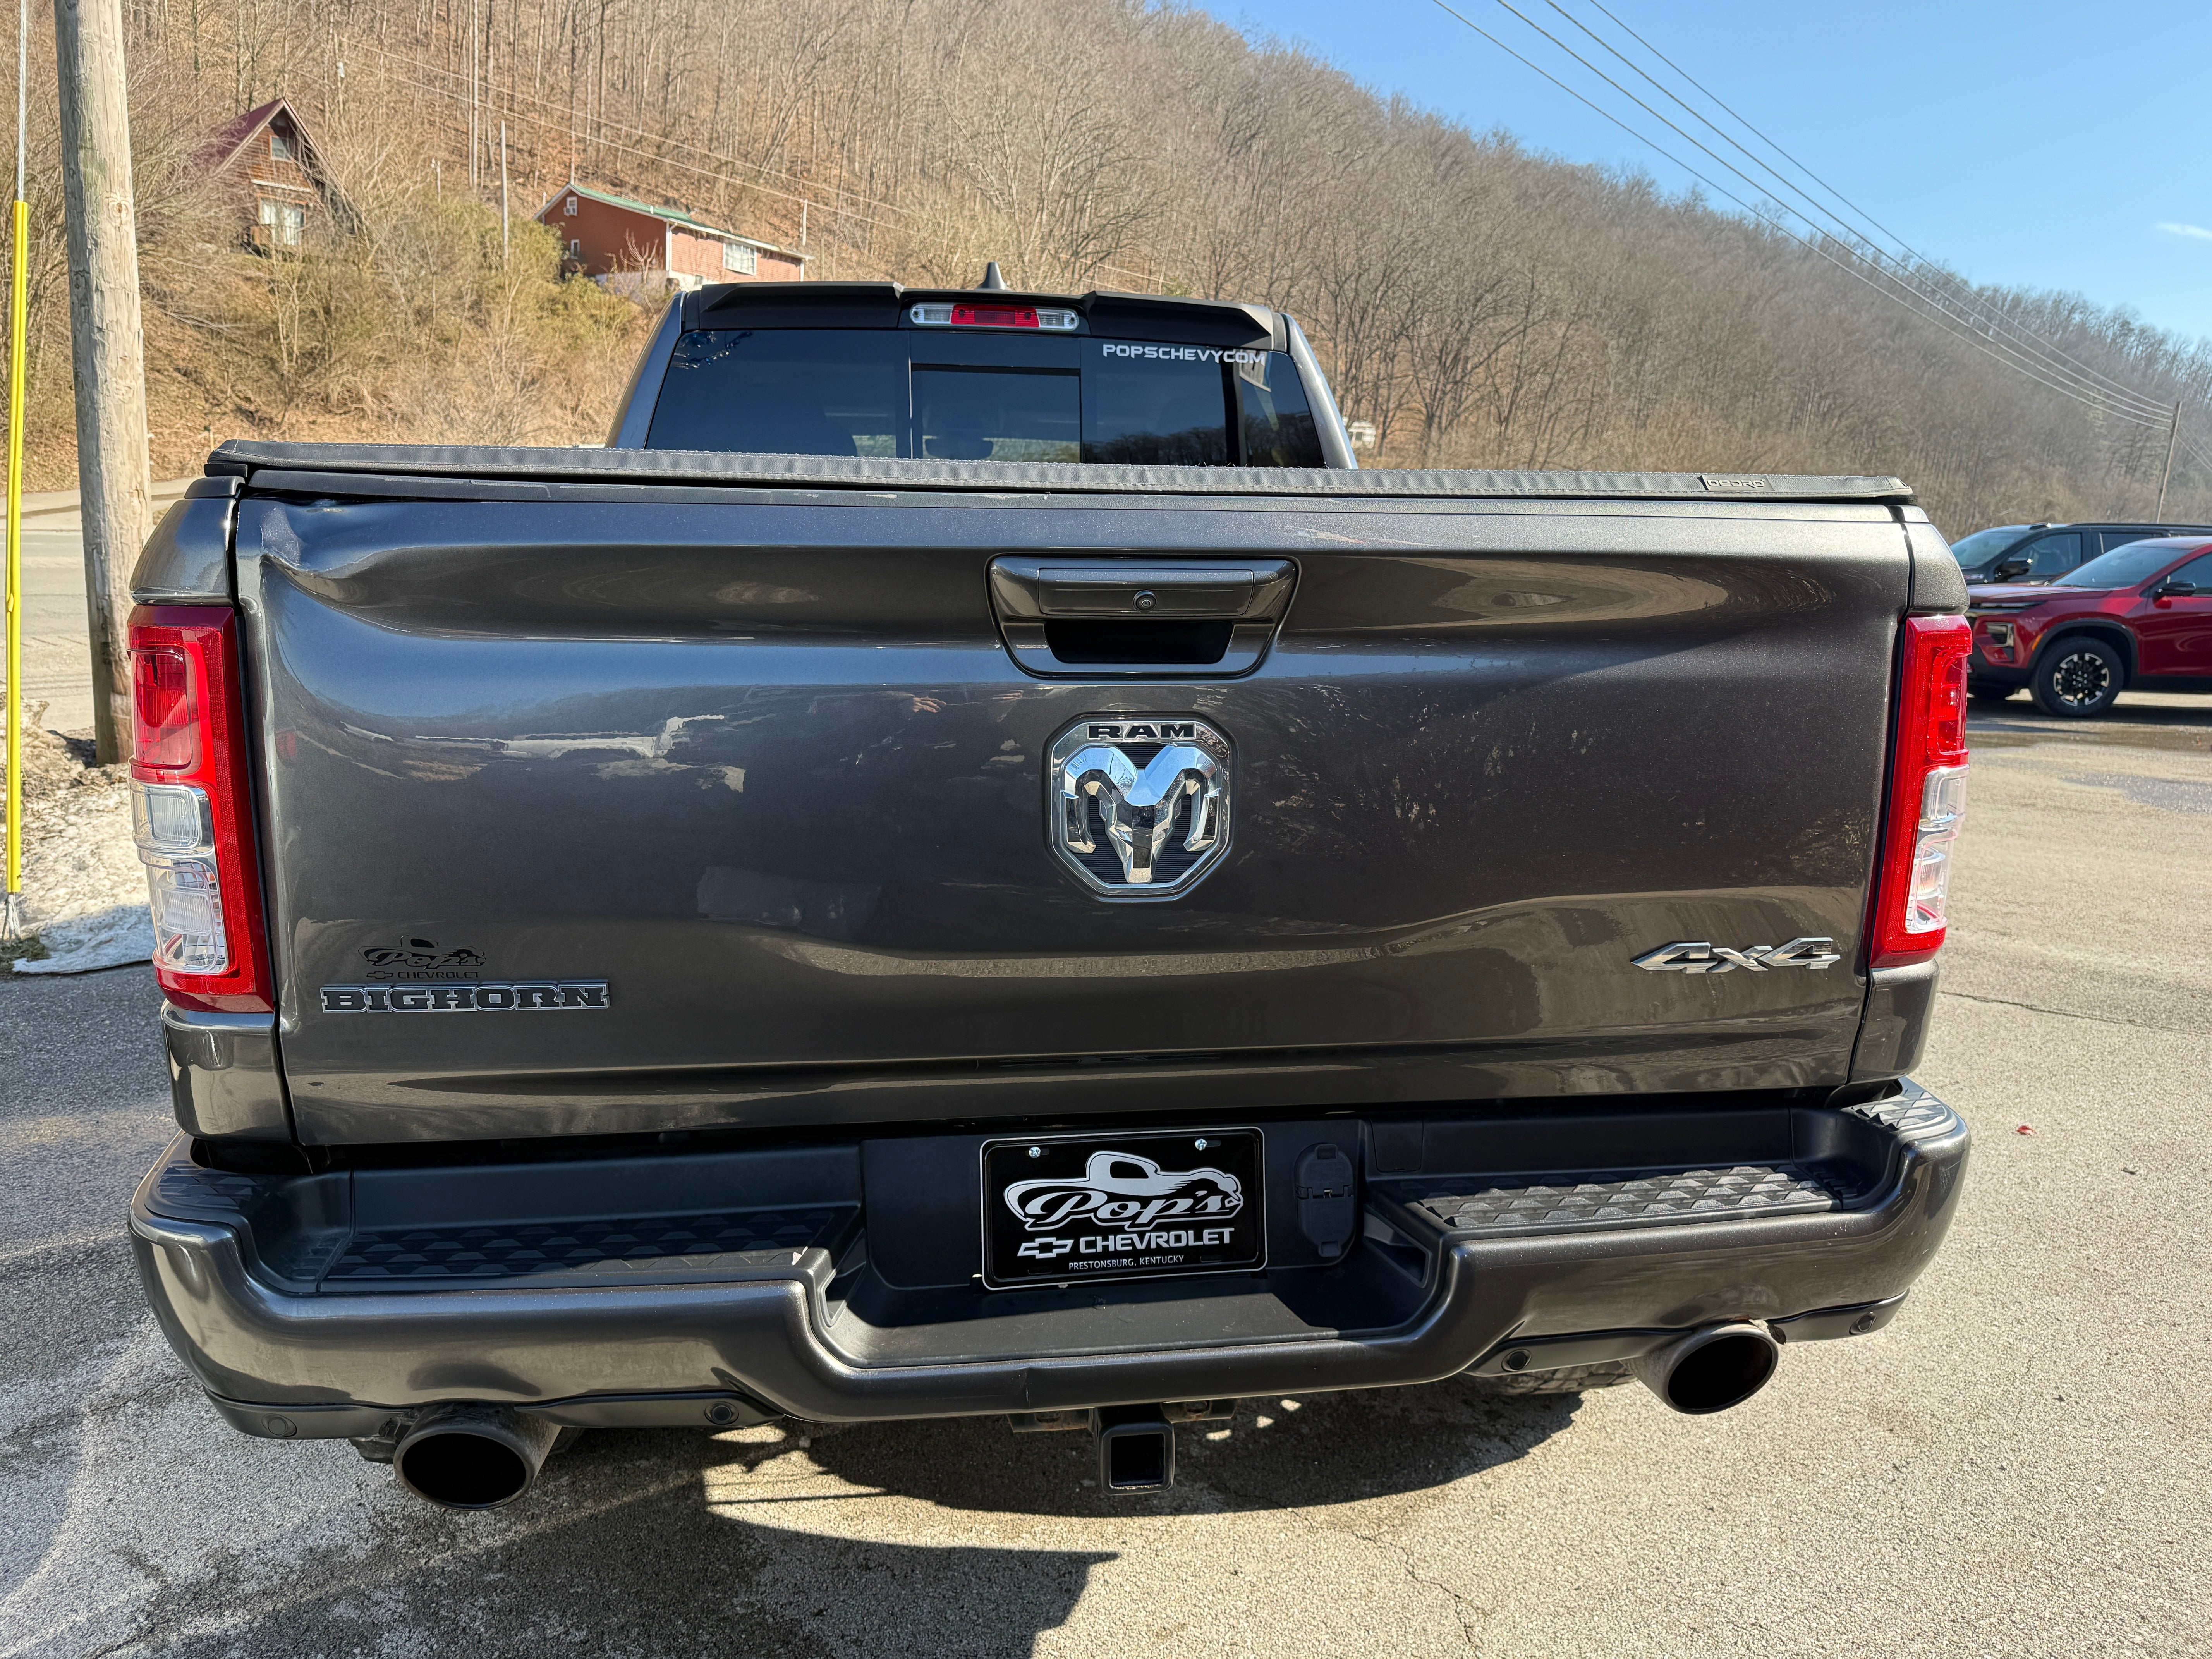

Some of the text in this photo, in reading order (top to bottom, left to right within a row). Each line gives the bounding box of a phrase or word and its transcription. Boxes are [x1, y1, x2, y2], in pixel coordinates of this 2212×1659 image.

[1088, 725, 1195, 739] RAM
[320, 982, 609, 1013] BIGHORN
[1025, 1190, 1231, 1224] Pop's
[1079, 1228, 1235, 1254] CHEVROLET
[1068, 1255, 1184, 1270] PRESTONSBURG, KENTUCKY
